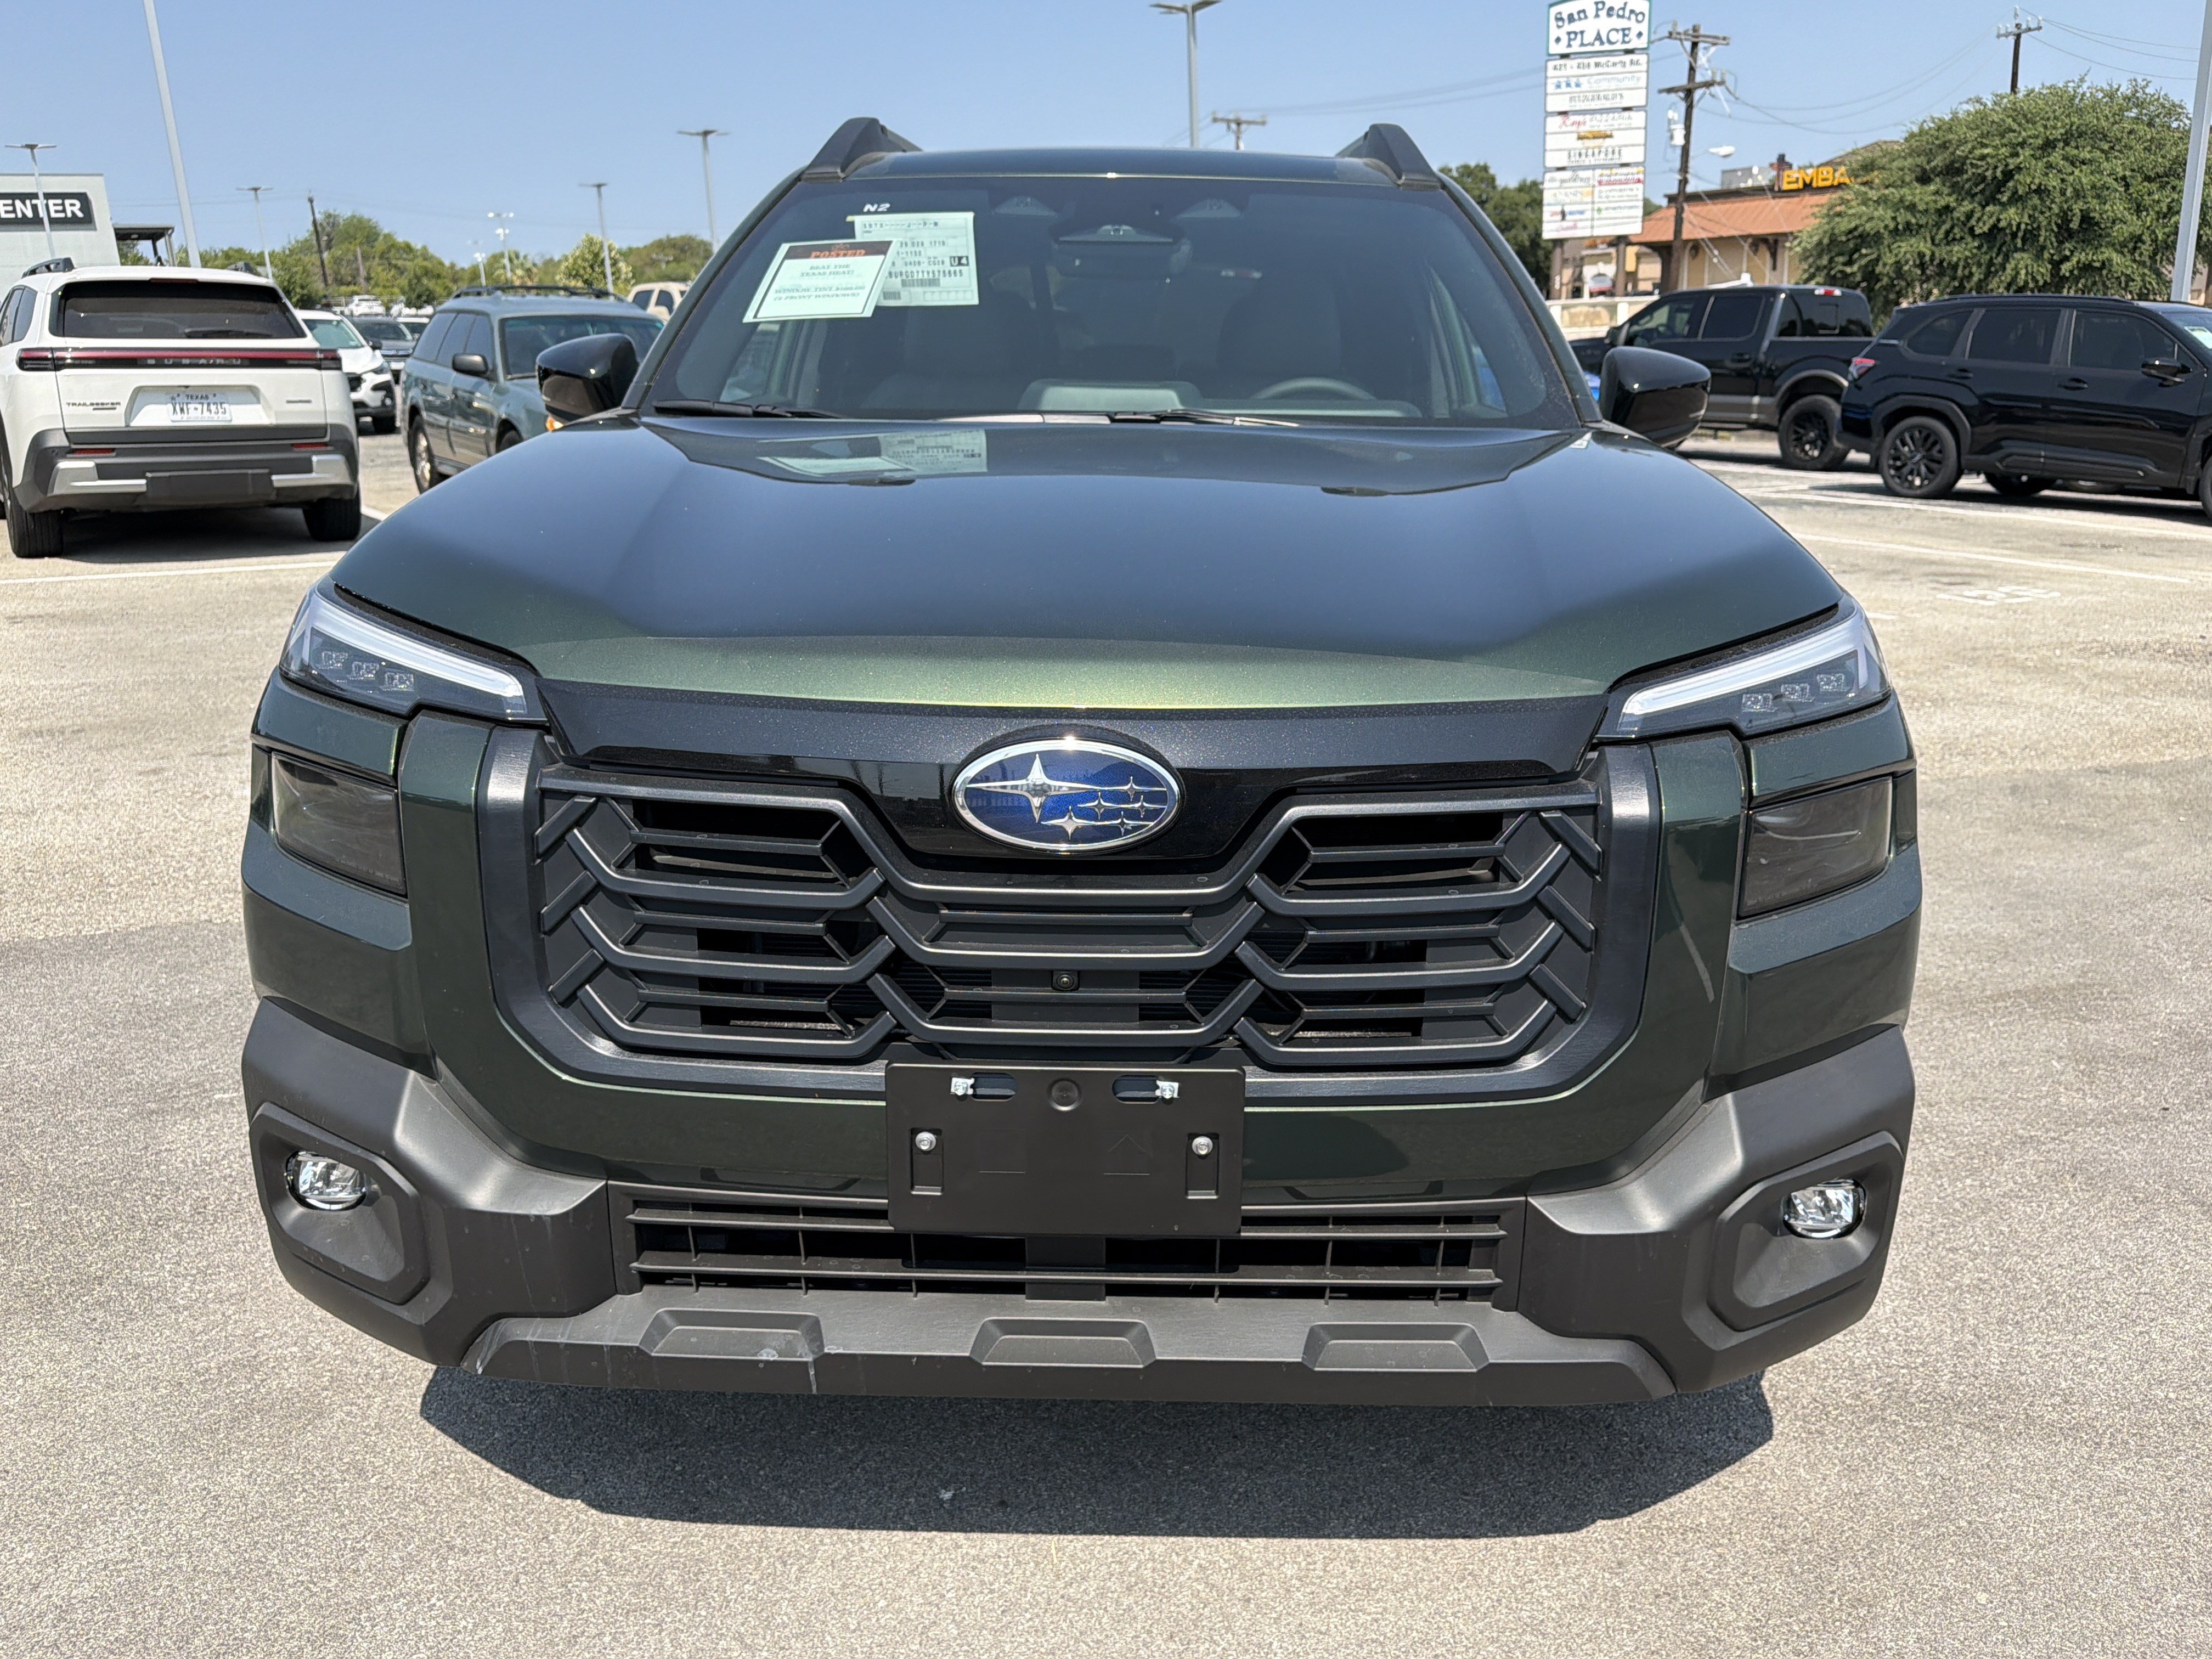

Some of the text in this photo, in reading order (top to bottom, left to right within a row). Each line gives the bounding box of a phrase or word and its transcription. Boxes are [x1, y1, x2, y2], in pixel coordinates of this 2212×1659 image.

[1554, 1, 1645, 29] San Pedro
[1566, 27, 1633, 48] PLACE
[863, 203, 890, 212] N2
